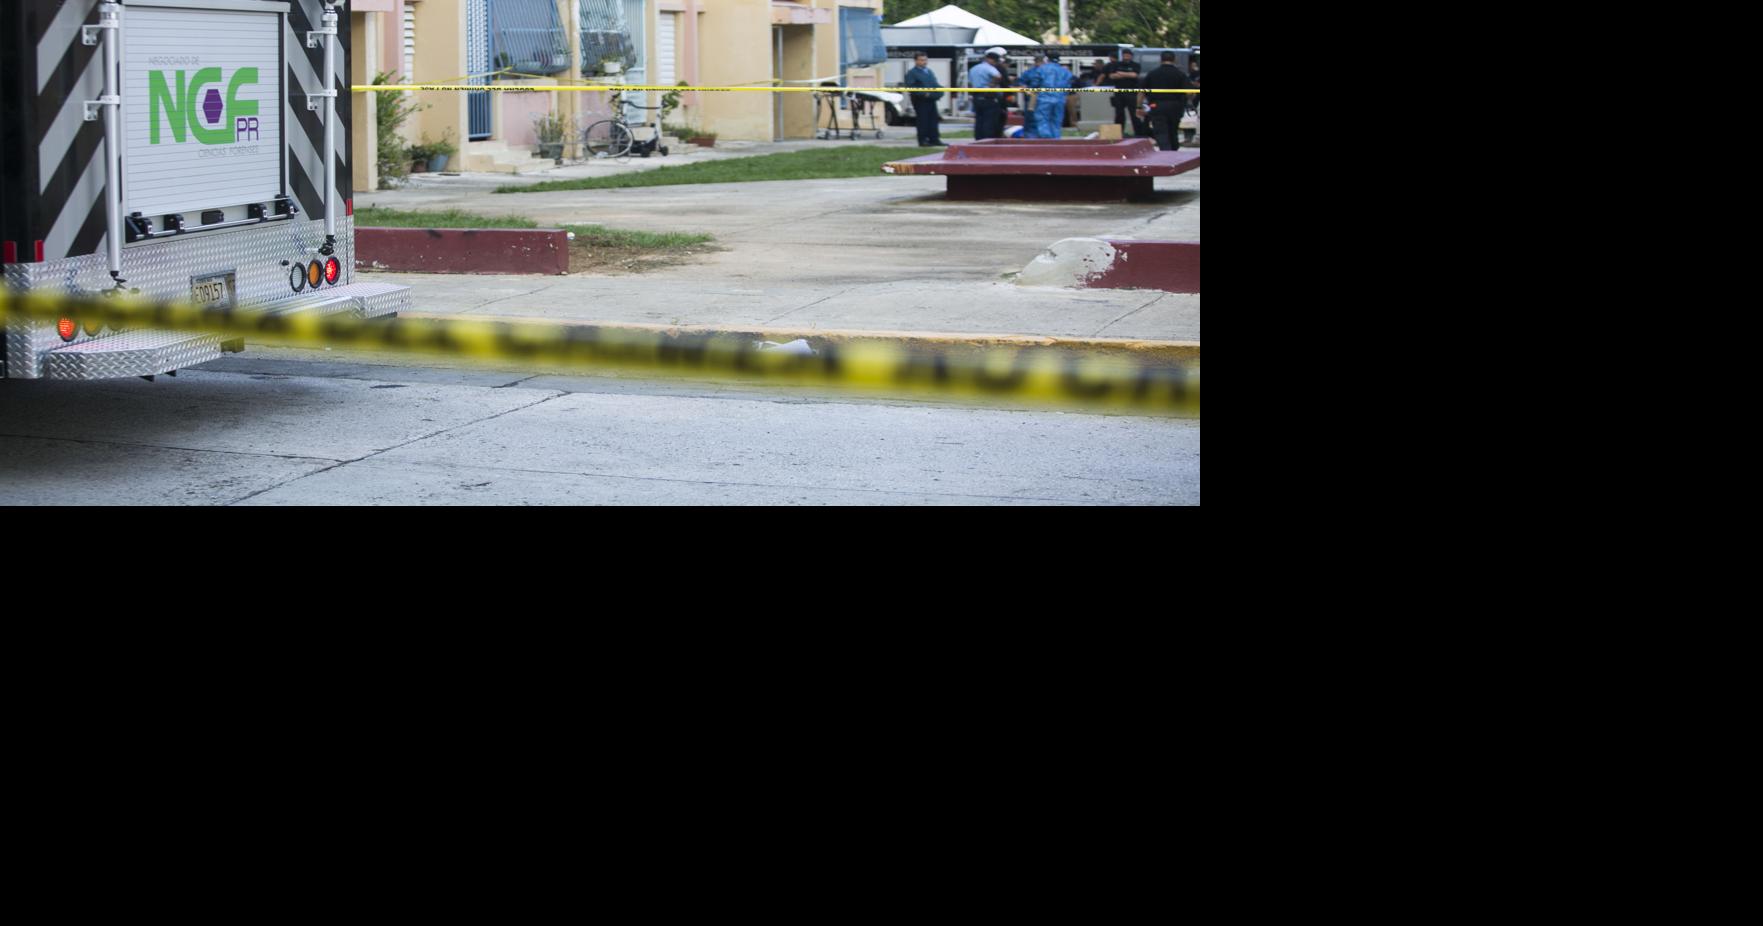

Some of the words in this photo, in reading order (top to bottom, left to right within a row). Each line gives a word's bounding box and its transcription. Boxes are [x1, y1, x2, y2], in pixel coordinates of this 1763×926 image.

[191, 55, 200, 65] DE
[236, 117, 259, 142] PR
[199, 147, 226, 158] CIENCIAS
[229, 145, 259, 156] FORENSES
